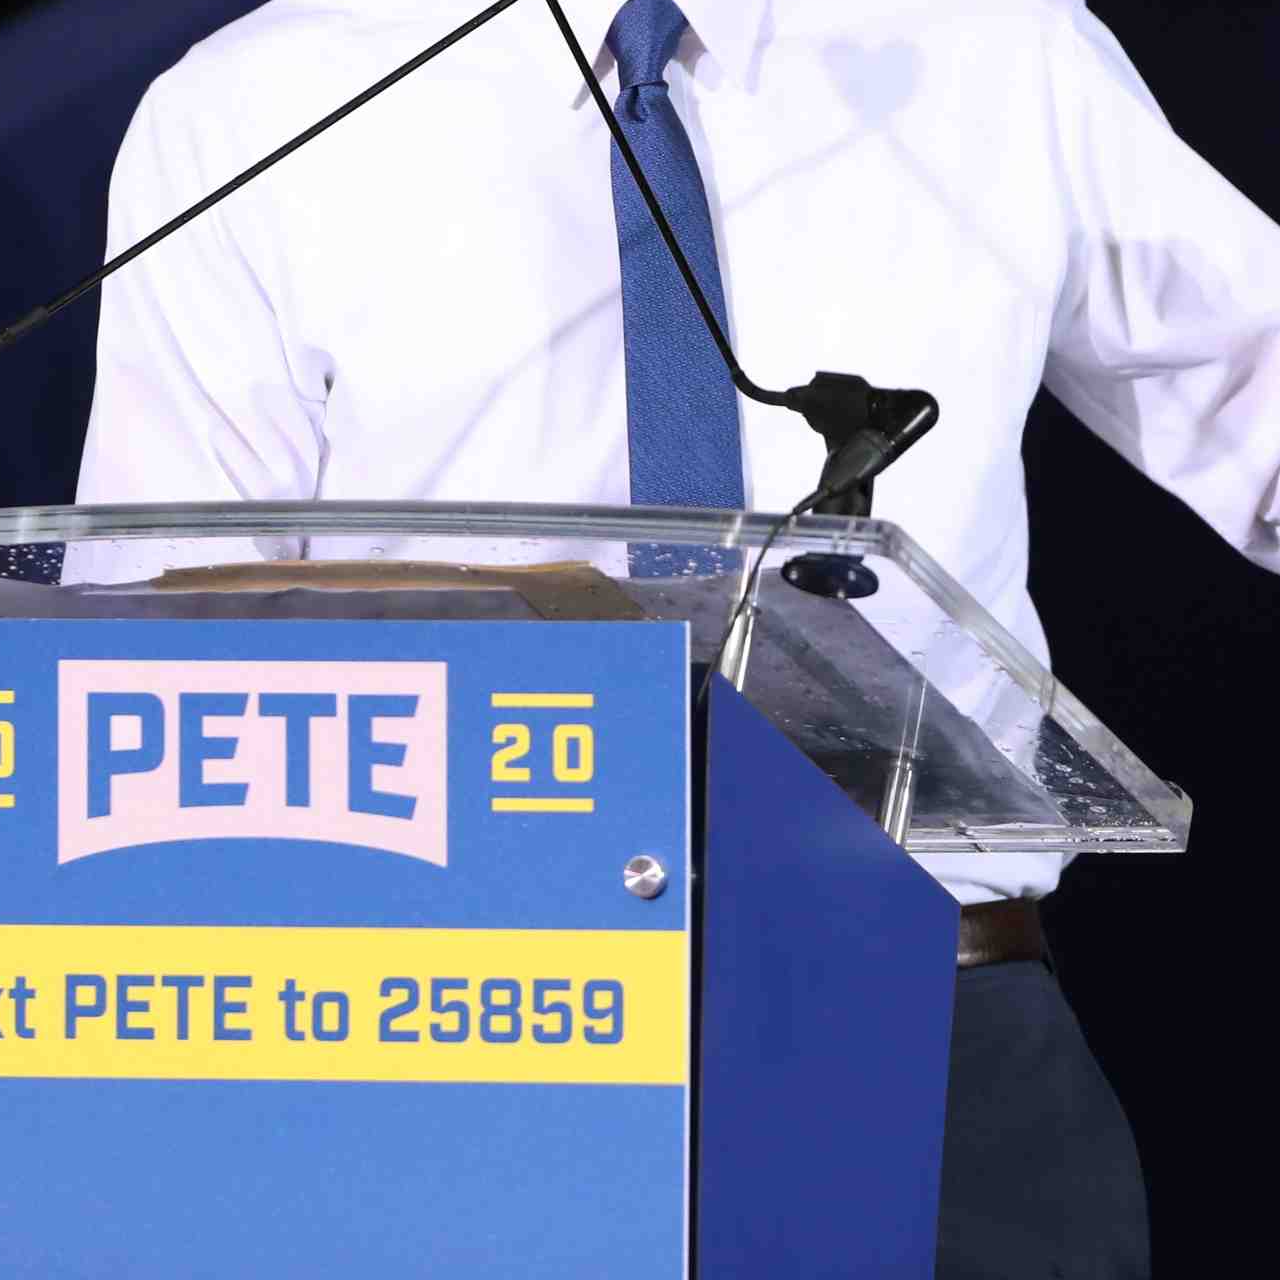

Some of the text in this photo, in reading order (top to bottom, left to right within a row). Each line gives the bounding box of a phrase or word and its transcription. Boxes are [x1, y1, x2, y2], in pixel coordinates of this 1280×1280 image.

[87, 691, 420, 820] PETE
[491, 724, 594, 782] 20
[65, 974, 252, 1041] PETE
[278, 979, 350, 1042] to
[379, 977, 624, 1045] 25859
